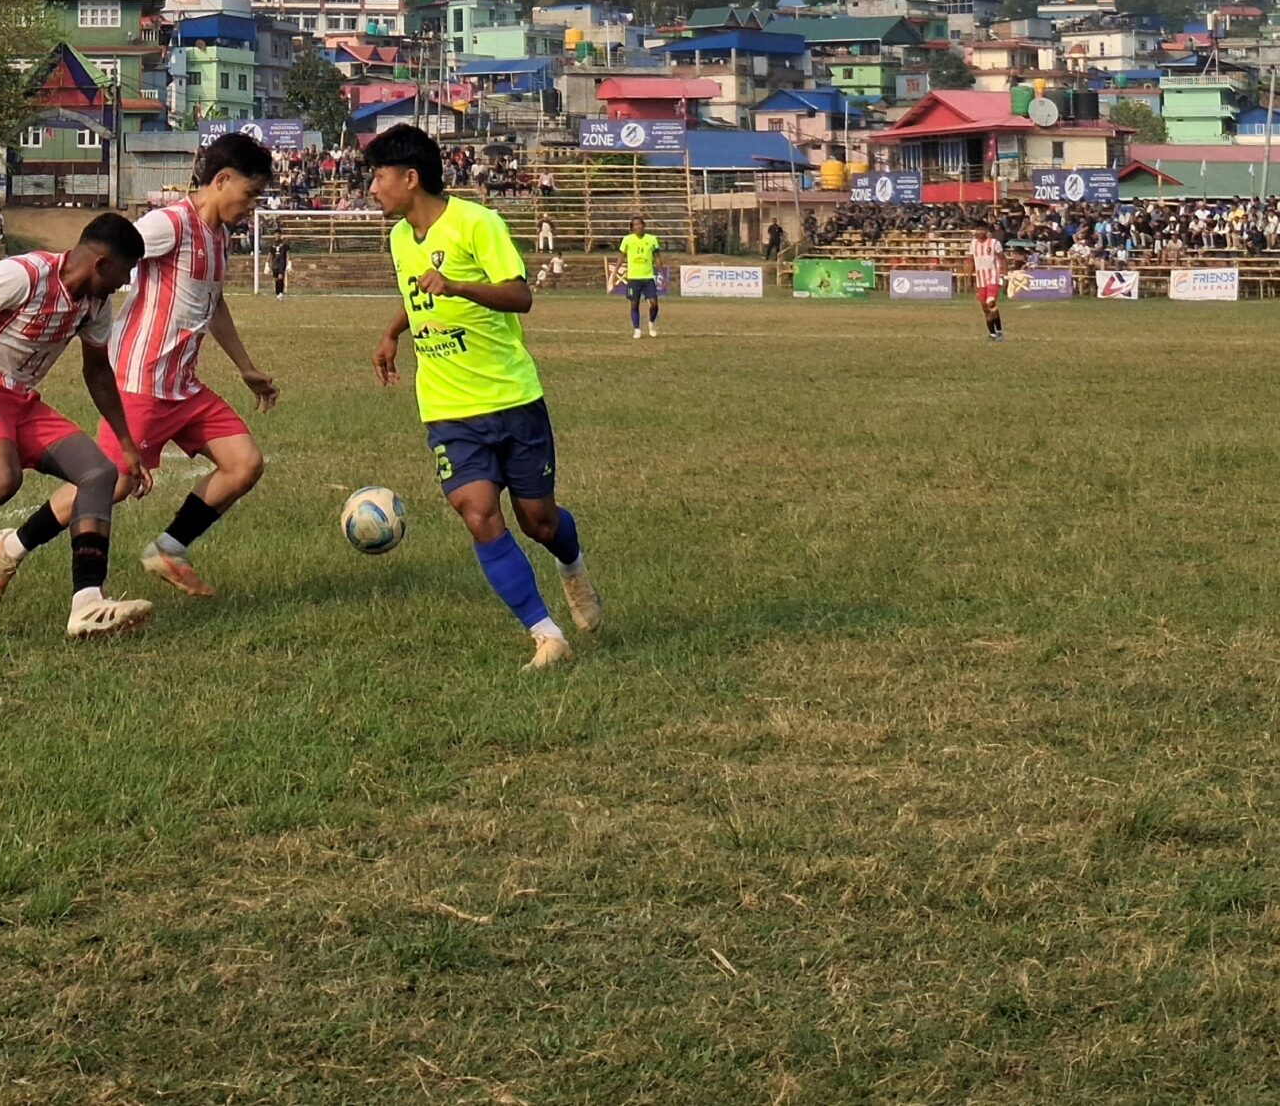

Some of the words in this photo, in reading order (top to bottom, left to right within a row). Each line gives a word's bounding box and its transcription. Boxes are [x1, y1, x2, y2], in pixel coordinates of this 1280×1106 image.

[210, 124, 226, 133] FAN
[591, 123, 608, 132] FAN
[582, 134, 614, 145] ZONE
[857, 178, 869, 187] FAN
[1041, 175, 1055, 184] FAN
[850, 189, 872, 201] ZONE
[1034, 186, 1060, 200] ZONE
[707, 270, 758, 280] FRIENDS
[1193, 272, 1235, 282] FRIENDS
